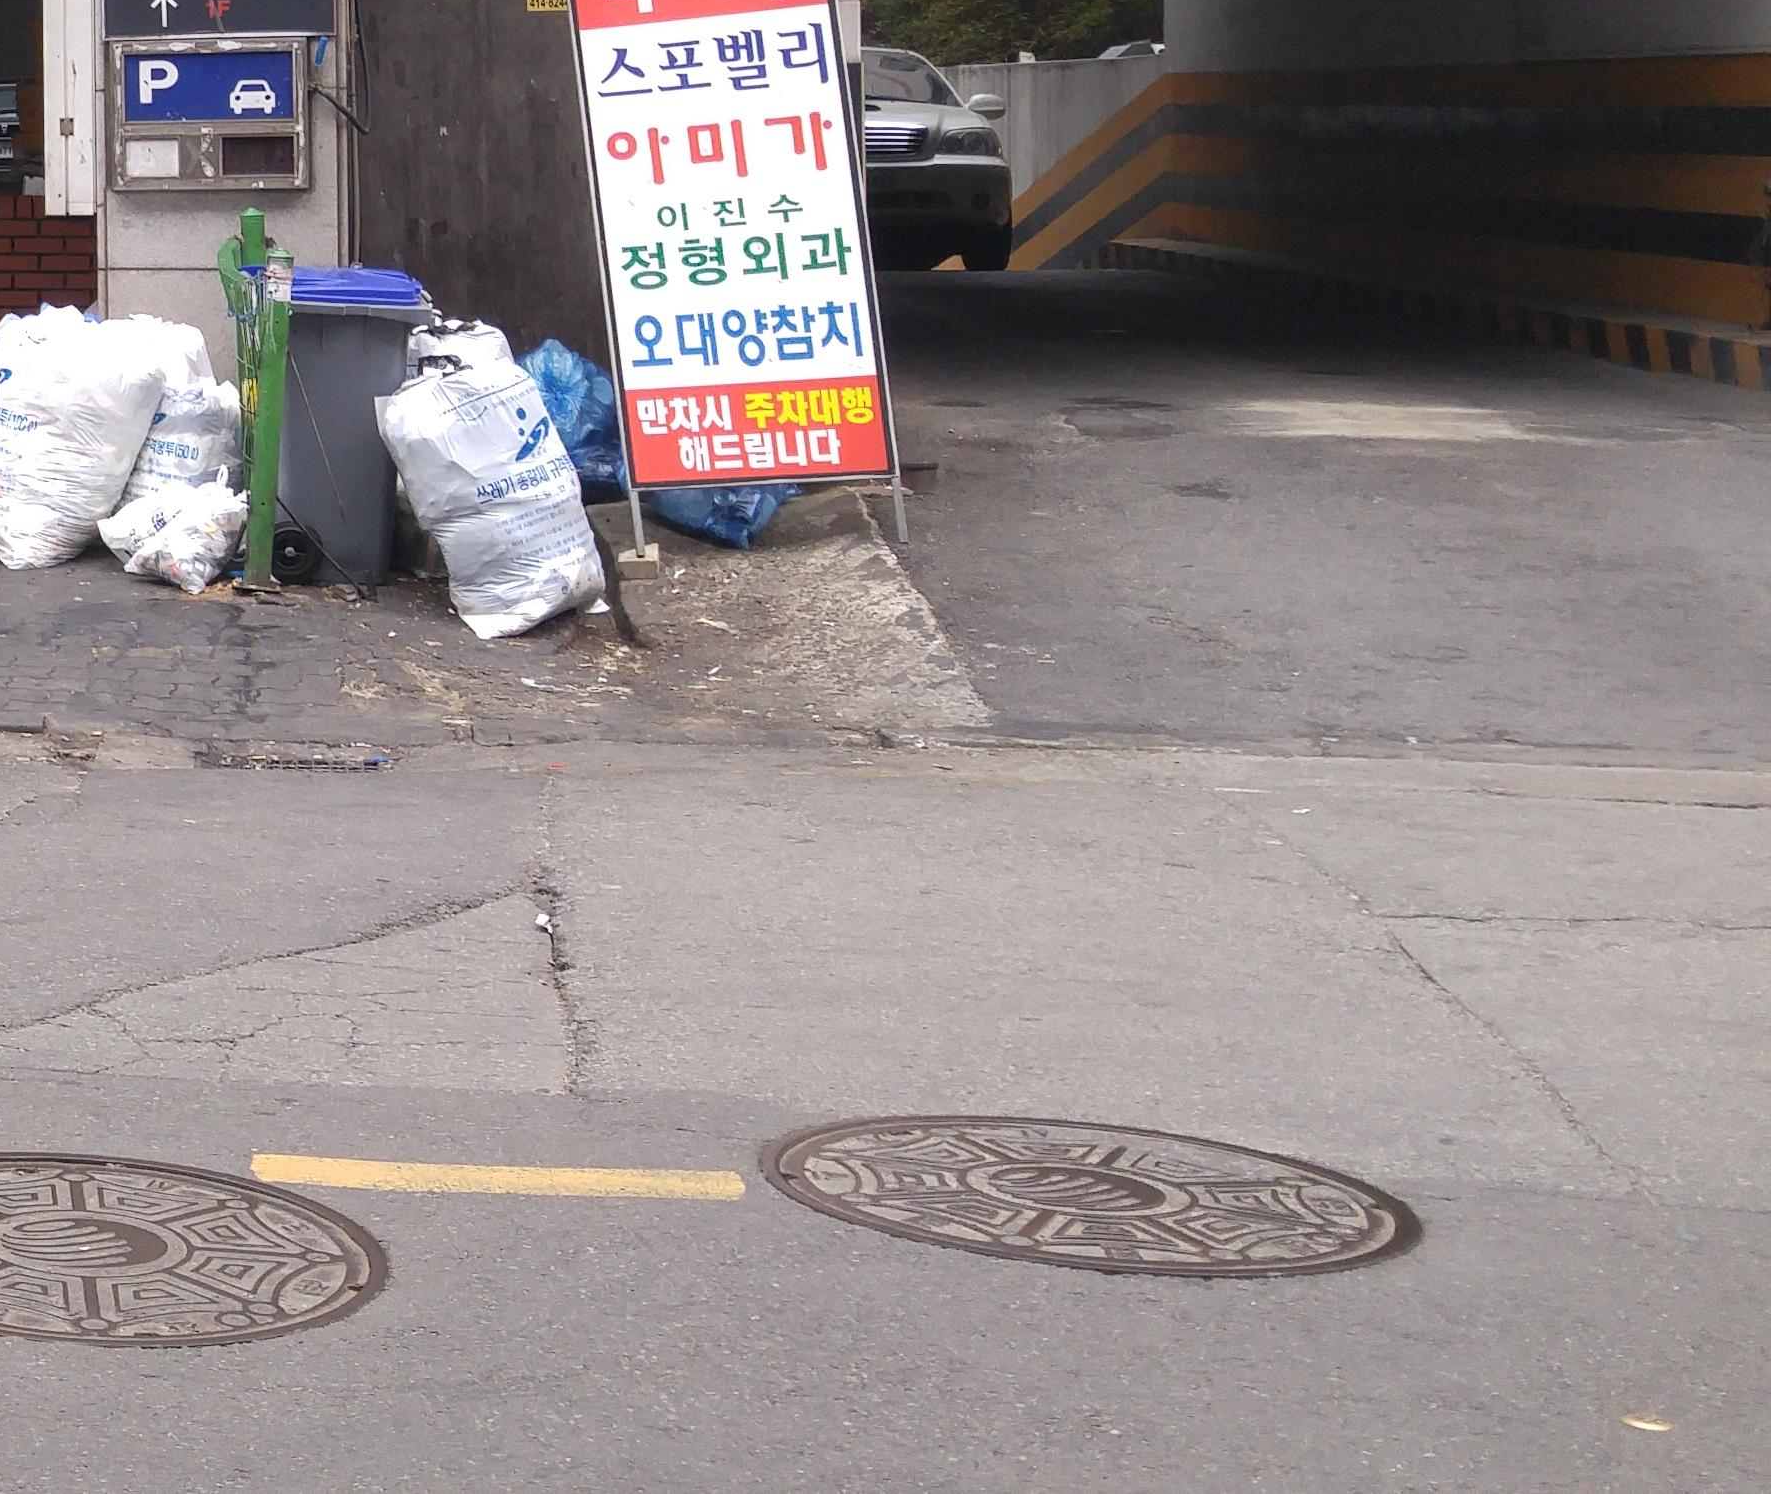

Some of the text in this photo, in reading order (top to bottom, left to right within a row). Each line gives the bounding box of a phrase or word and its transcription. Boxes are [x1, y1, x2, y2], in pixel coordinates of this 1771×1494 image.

[206, 0, 231, 17] 1F
[138, 60, 179, 104] P
[597, 22, 829, 98] 스포벨리
[606, 111, 833, 185] 아미가
[657, 192, 803, 231] 이진수
[621, 227, 853, 290] 정형외과
[631, 301, 863, 370] 오대양참치
[636, 386, 874, 435] 만차시 주차대행
[678, 429, 841, 471] 해드립니다
